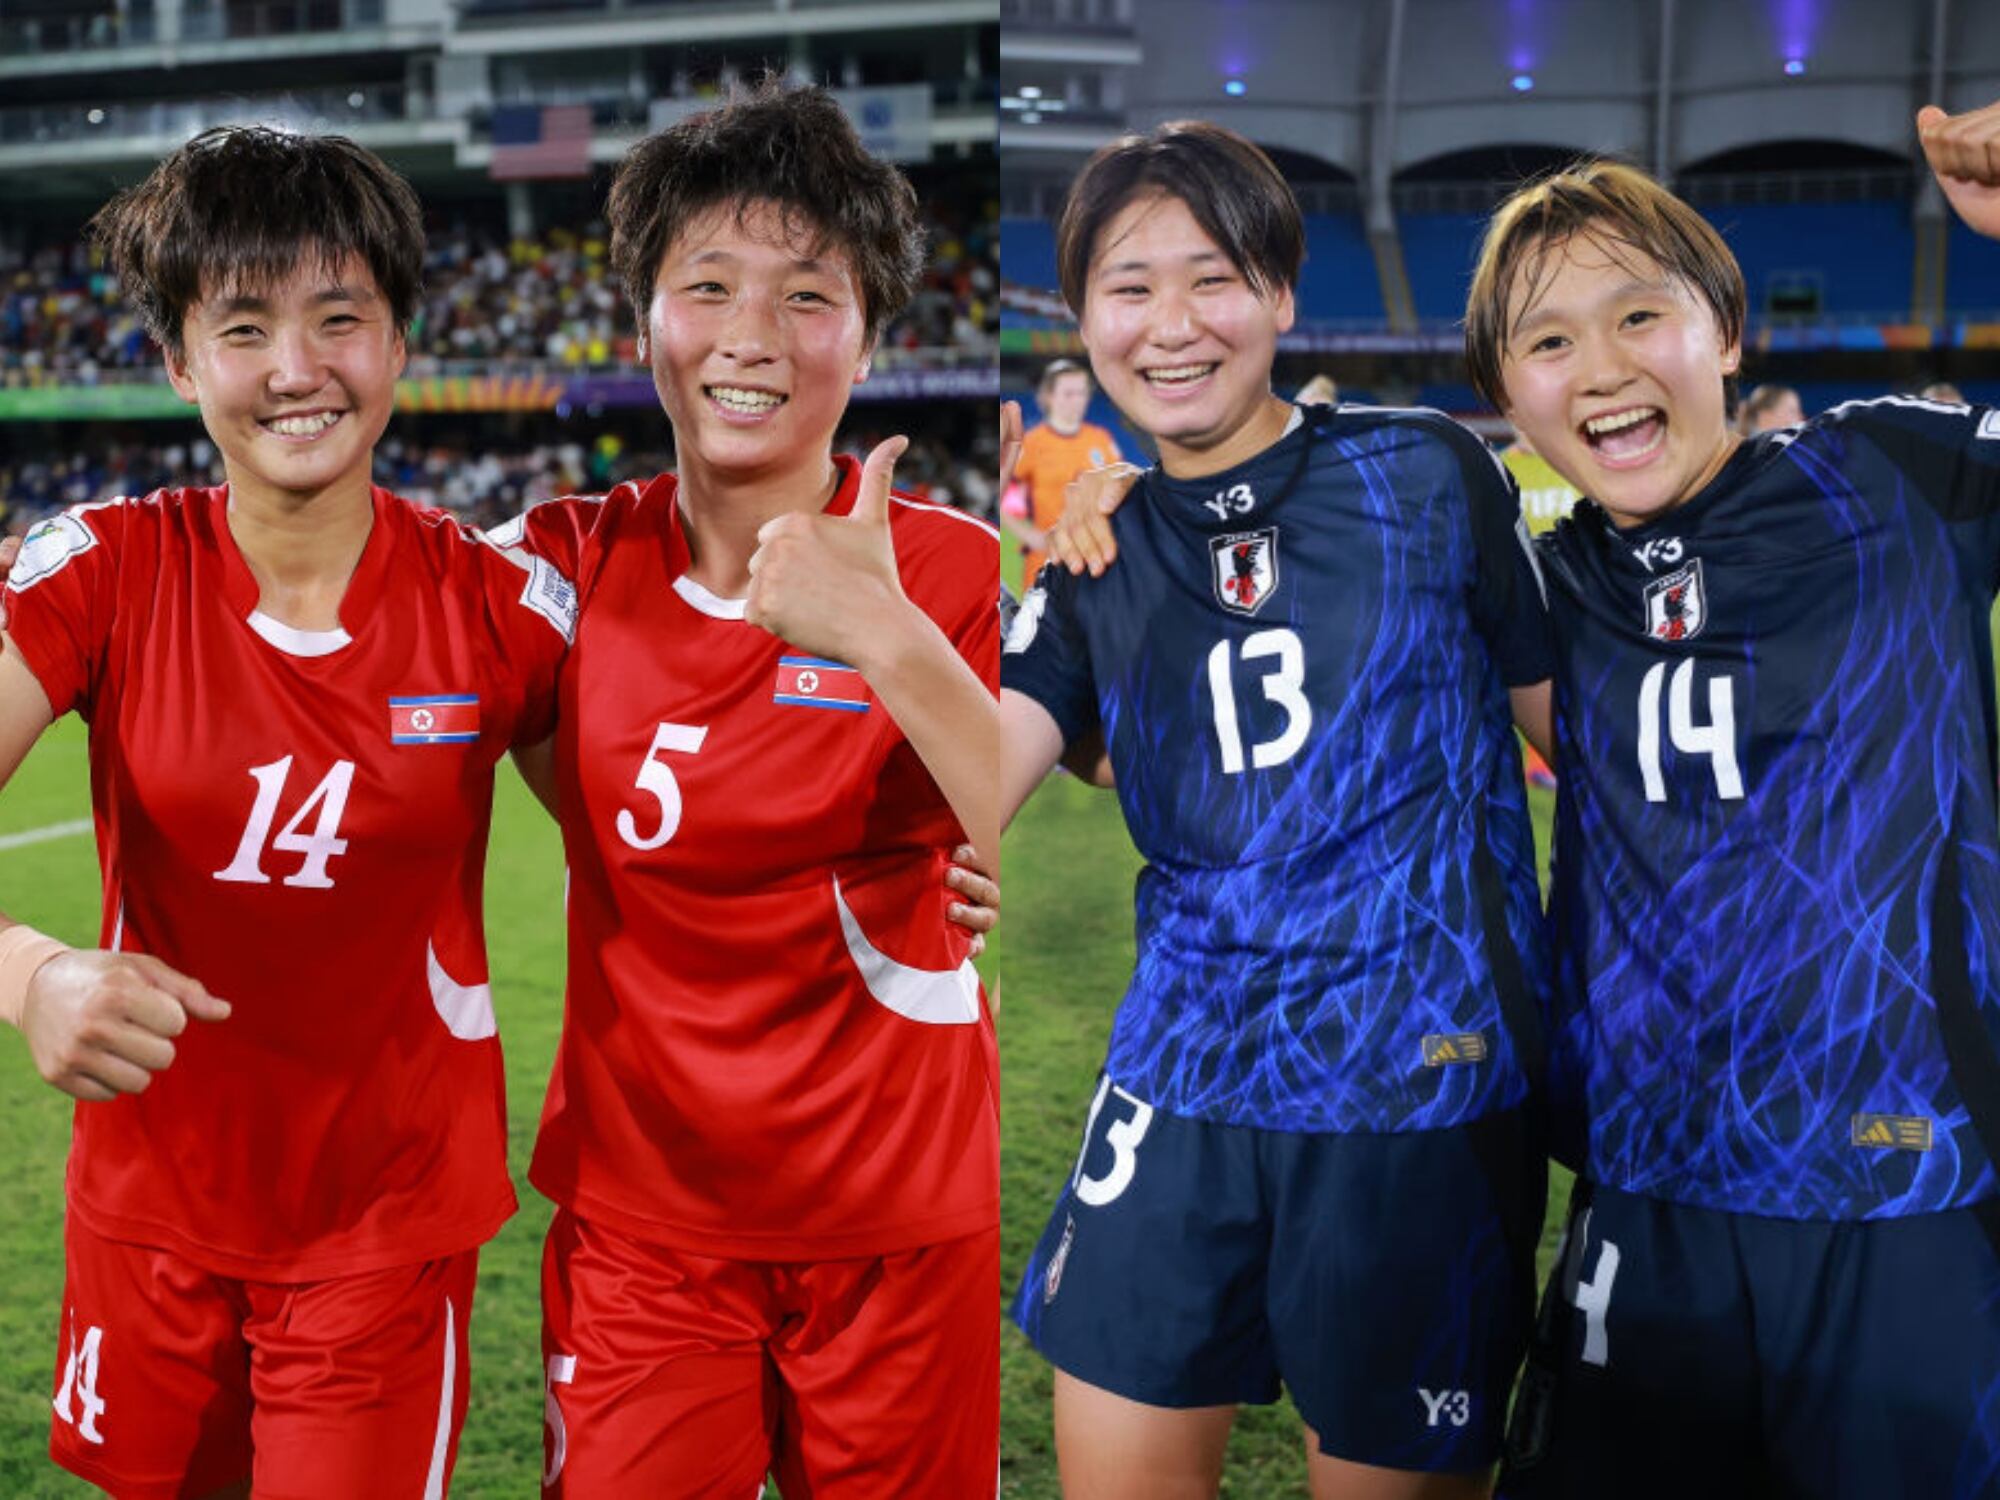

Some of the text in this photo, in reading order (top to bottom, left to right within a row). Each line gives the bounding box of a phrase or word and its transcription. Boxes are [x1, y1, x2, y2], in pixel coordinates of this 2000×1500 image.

[1203, 483, 1256, 521] Y-3
[1207, 628, 1313, 774] 13
[1637, 656, 1745, 803] 14
[212, 754, 356, 889] 14
[616, 721, 709, 851] 5
[52, 1306, 105, 1445] 14
[1418, 1389, 1470, 1427] Y-3
